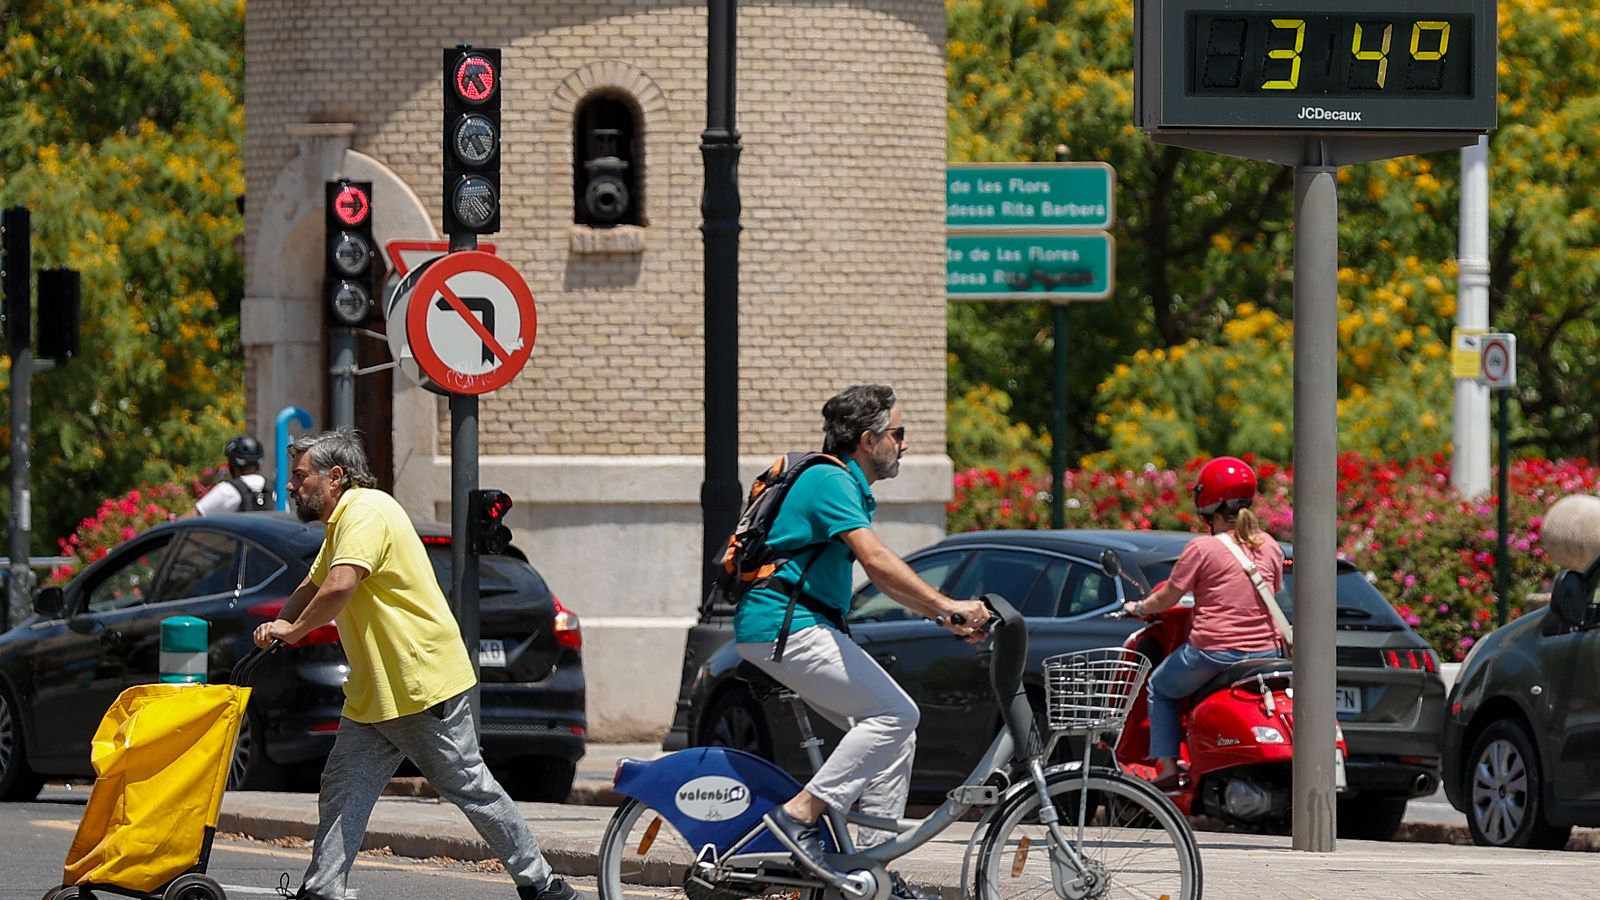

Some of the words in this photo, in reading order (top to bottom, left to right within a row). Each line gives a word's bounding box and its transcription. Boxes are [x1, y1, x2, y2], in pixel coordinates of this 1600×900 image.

[1297, 107, 1361, 122] JCDecaux
[950, 180, 971, 194] de
[1009, 178, 1050, 194] Flors
[1001, 200, 1034, 217] Rita
[970, 247, 990, 262] de
[1028, 246, 1080, 262] Flores
